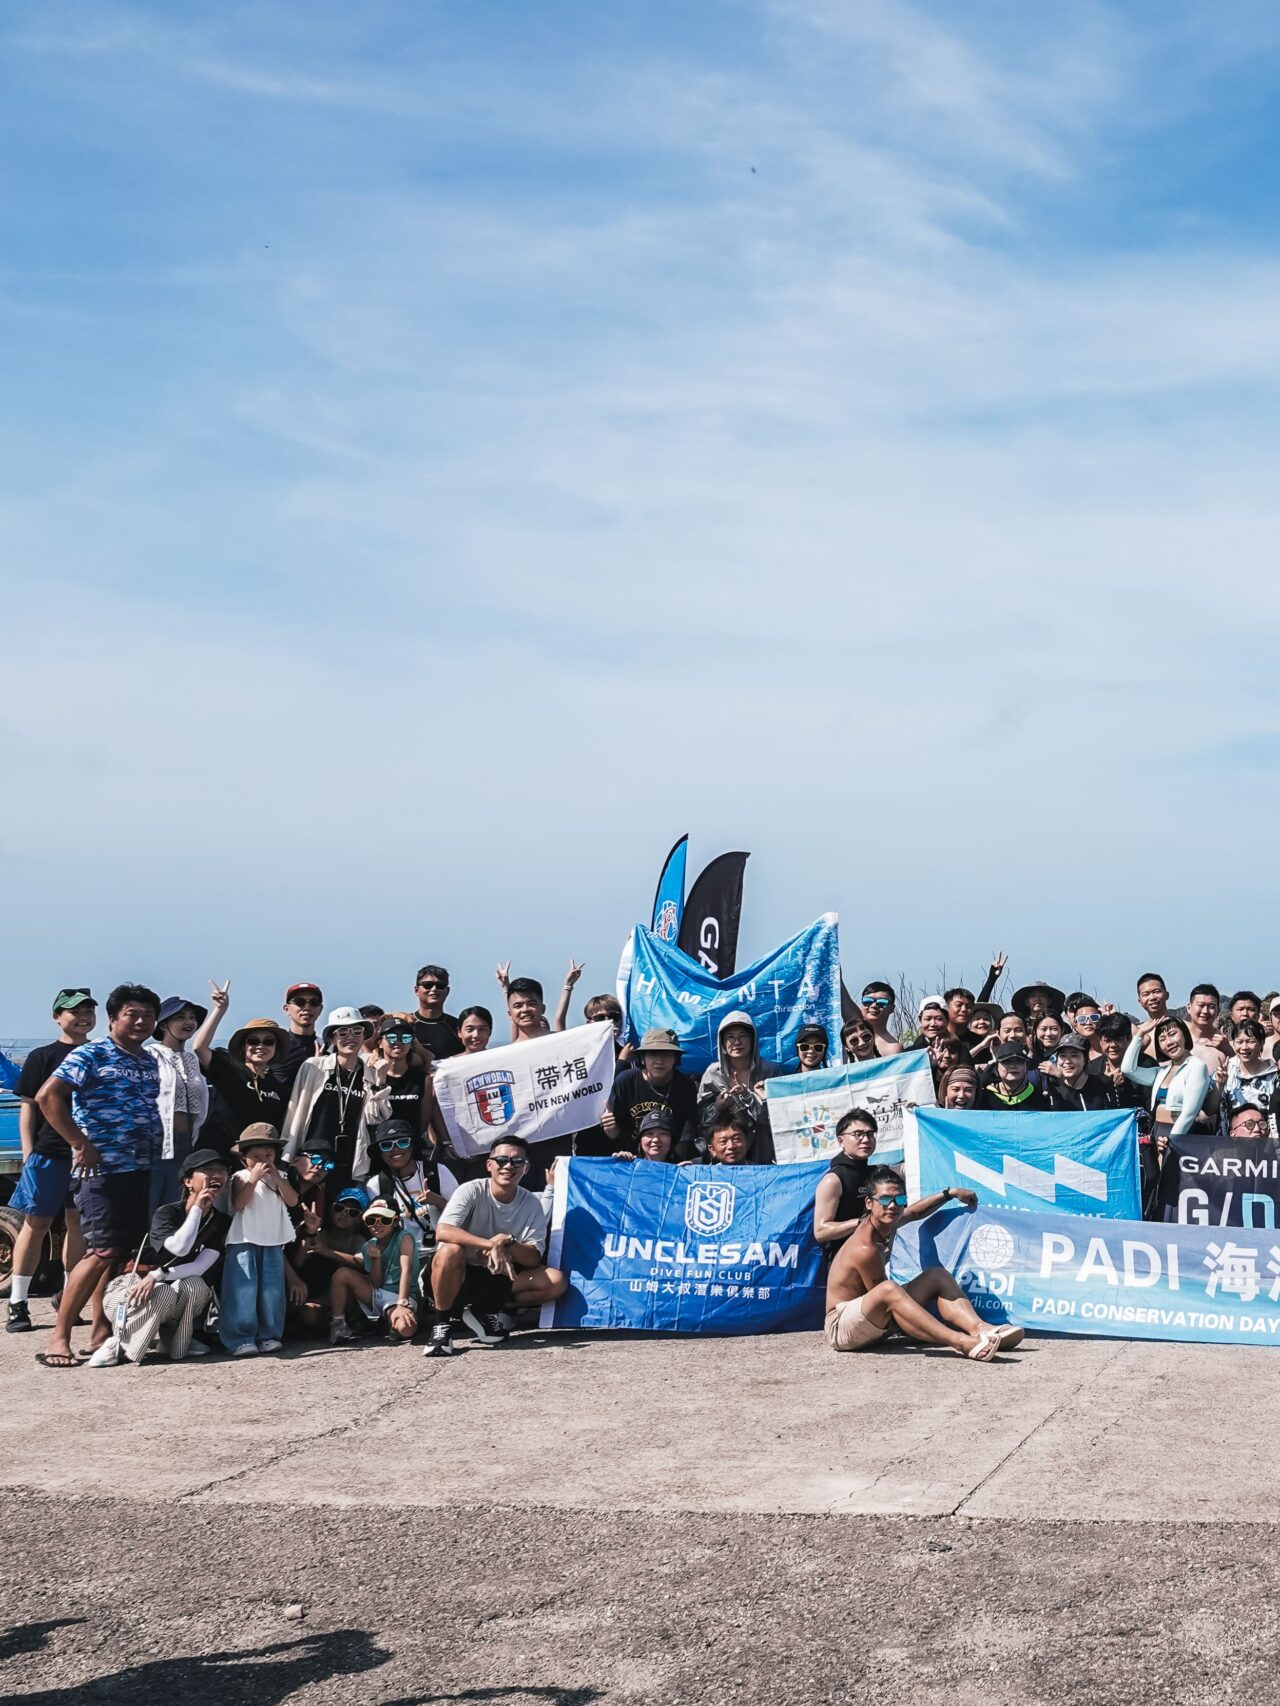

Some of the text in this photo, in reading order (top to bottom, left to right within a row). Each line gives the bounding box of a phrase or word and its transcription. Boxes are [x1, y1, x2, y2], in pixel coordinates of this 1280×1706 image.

[699, 916, 721, 975] GA
[535, 1057, 588, 1090] 帶福
[529, 1082, 603, 1112] DIVE NEW WORLD
[604, 1233, 799, 1269] UNCLESAM
[1039, 1232, 1180, 1291] PADI
[650, 1267, 751, 1281] DIVE FUN CLUB
[958, 1270, 1016, 1297] PADI
[1032, 1298, 1075, 1316] PADI
[1081, 1302, 1234, 1331] CONSERVATION
[1240, 1316, 1280, 1334] DAY
